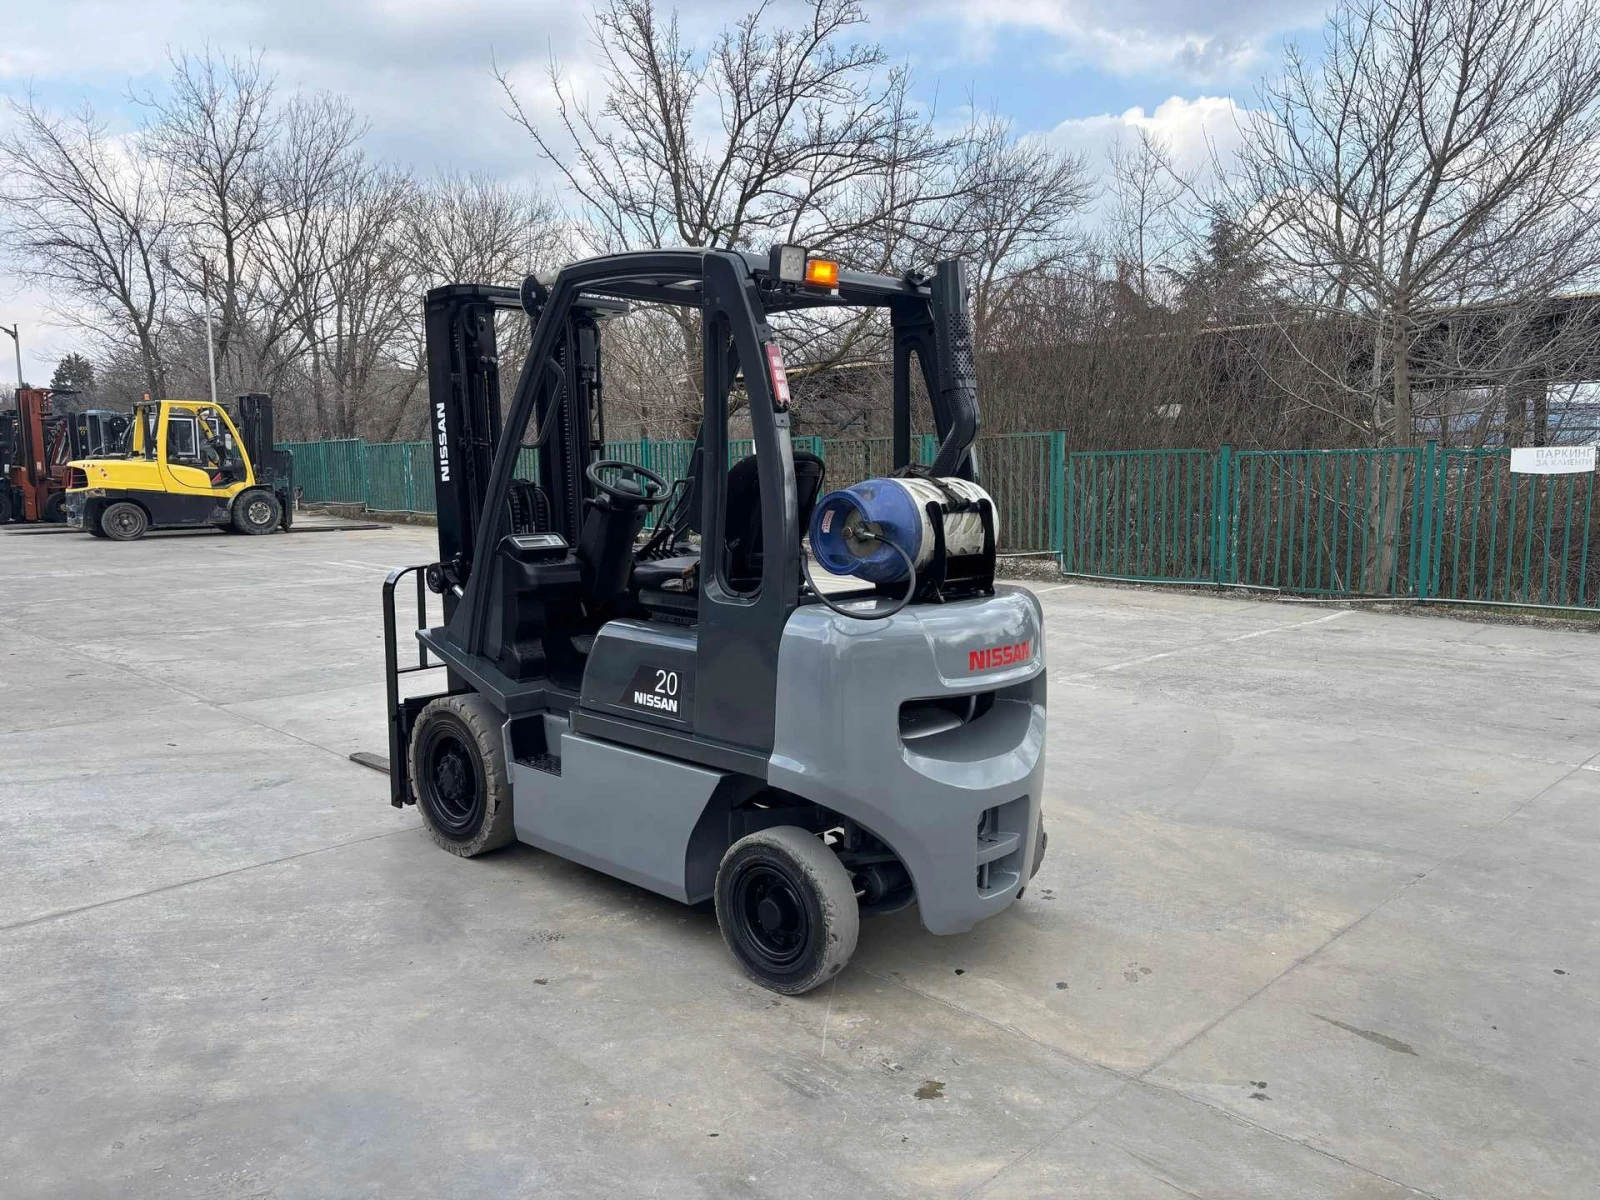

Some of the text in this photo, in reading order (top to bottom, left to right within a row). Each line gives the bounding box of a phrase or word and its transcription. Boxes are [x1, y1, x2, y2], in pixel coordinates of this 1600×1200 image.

[436, 402, 450, 482] NISSAN
[1535, 448, 1594, 459] ПАРКИНГ
[1535, 459, 1549, 467] ЗА
[969, 640, 1031, 671] NISSAN
[655, 669, 678, 696] 20
[634, 691, 678, 713] NISSAN
